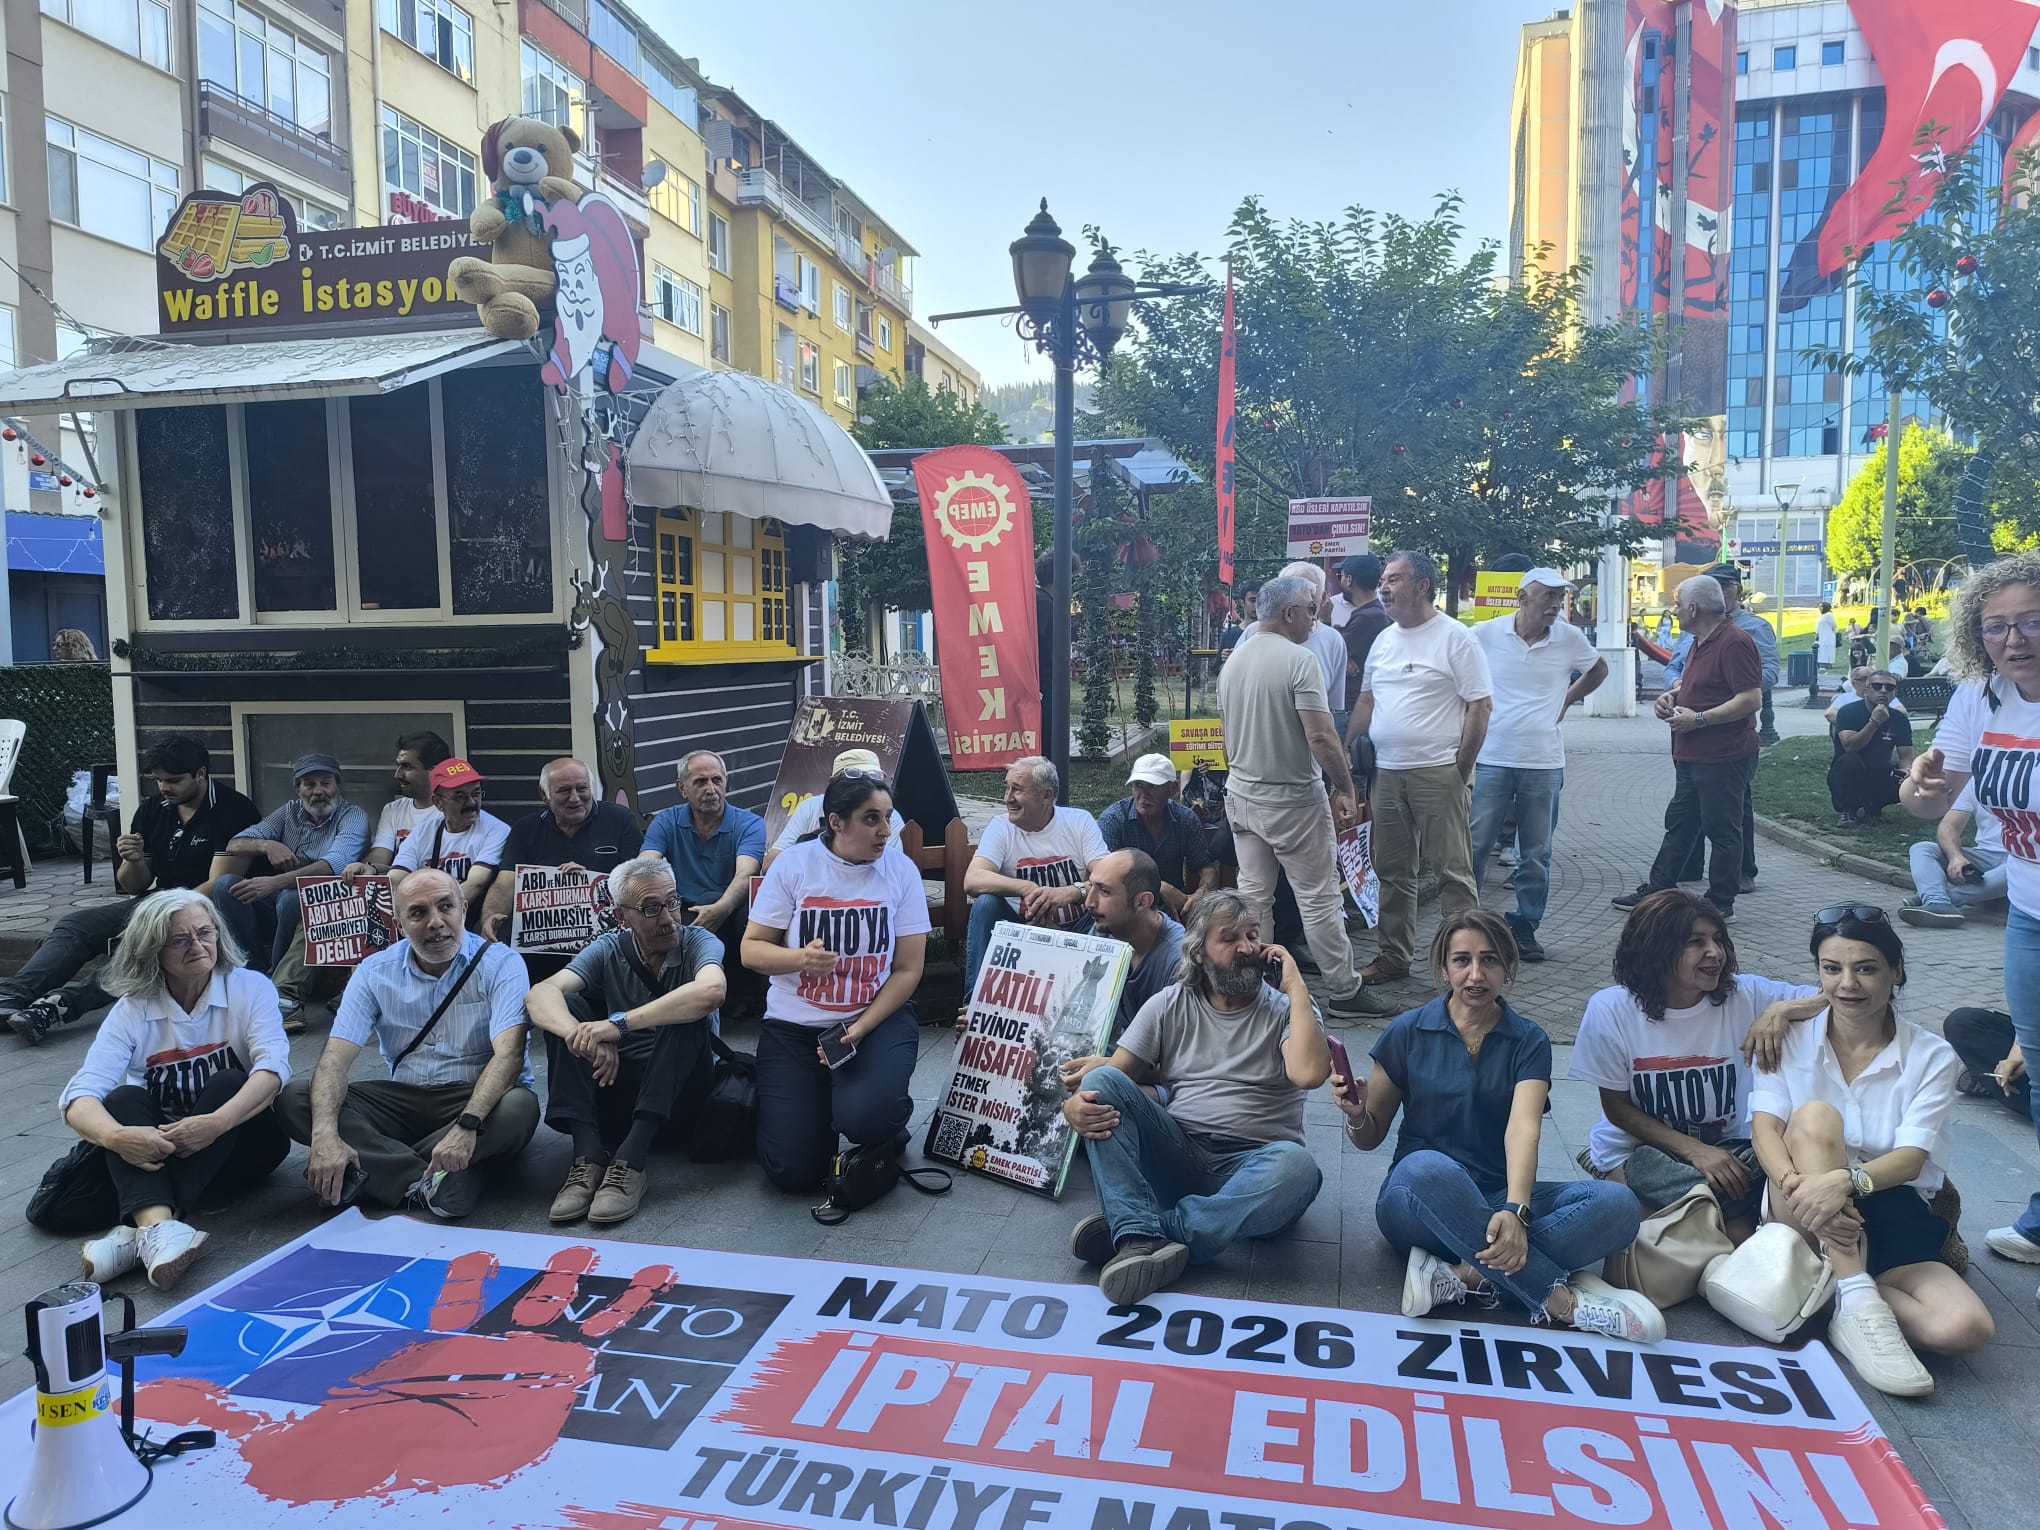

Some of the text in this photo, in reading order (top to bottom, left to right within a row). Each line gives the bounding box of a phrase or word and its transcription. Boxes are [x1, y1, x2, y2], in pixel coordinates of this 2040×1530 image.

[401, 230, 493, 251] BELEDİYE
[163, 281, 279, 323] Waffle
[1307, 503, 1329, 513] ÜSLERİ
[1330, 502, 1368, 512] KAPATILSIN
[1331, 523, 1366, 537] ÇIKILSIN!
[837, 719, 865, 731] İZMİT
[841, 710, 859, 719] T.C.
[834, 731, 886, 744] BELEDİYESİ
[1181, 728, 1208, 740] SAVAŞA
[1339, 839, 1361, 890] HOME
[1349, 839, 1363, 874] GO
[522, 872, 589, 891] ABD VE NATO'YA
[308, 897, 366, 926] ABD VE NATO
[521, 887, 592, 910] KARŞI DURMAK
[310, 917, 368, 942] CUMHURİYETİ
[522, 904, 593, 930] MONARŞİYE
[523, 927, 589, 944] KARŞI DURMAKTIR!
[800, 906, 890, 956] NATO'YA
[316, 938, 362, 965] DEĞİL!
[990, 942, 1022, 970] BİR
[977, 967, 1056, 1017] KATİLİ
[968, 1011, 1030, 1044] EVİNDE
[1061, 1015, 1082, 1029] NATO
[958, 1035, 1038, 1083] MİSAFİR
[951, 1072, 991, 1095] ETMEK
[1633, 1063, 1737, 1123] NATO'YA
[945, 1087, 1021, 1124] İSTER MİSİN?
[990, 1155, 1043, 1178] EMEK PARTİSİ
[563, 1294, 744, 1339] NTO
[816, 1276, 1835, 1421] NATO 2026 ZİRVESİ
[49, 1399, 87, 1419] SEN
[791, 1332, 1880, 1530] İPTAL EDİLSİN!
[680, 1446, 1063, 1530] TÜRKİYE
